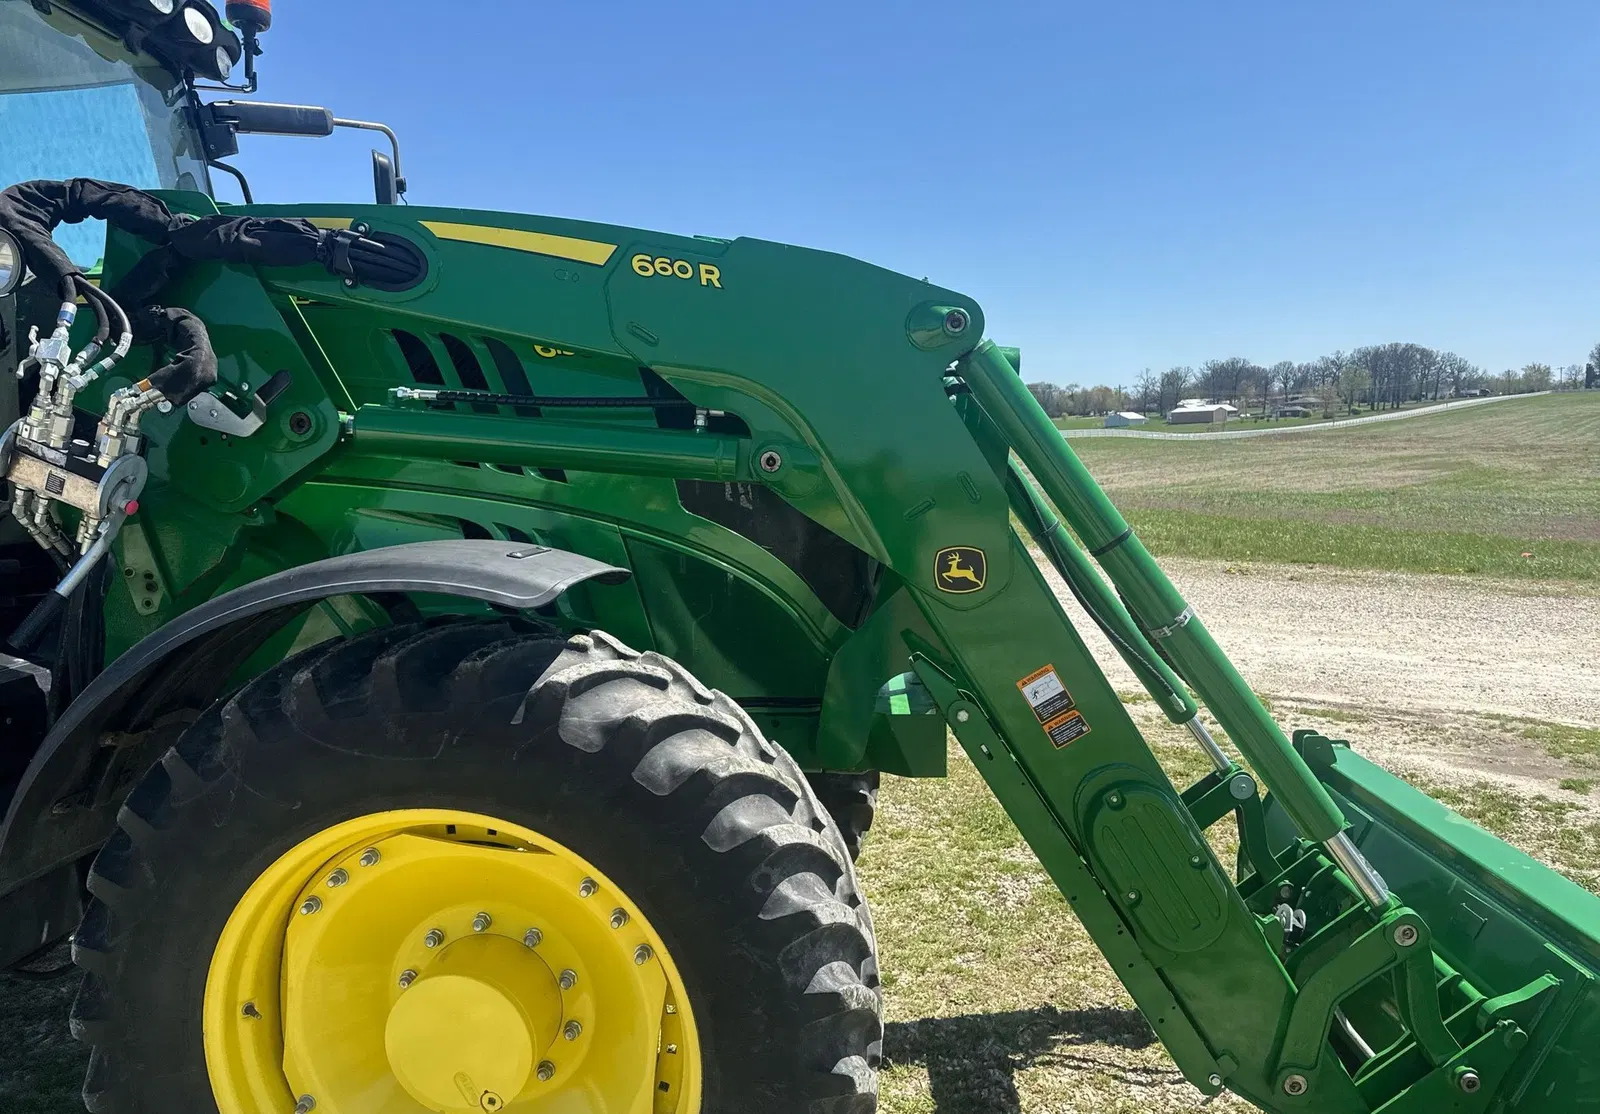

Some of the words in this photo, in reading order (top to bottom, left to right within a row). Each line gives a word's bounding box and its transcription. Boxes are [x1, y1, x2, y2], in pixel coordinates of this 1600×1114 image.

[631, 254, 694, 279] 660
[698, 262, 722, 288] R
[1026, 667, 1050, 683] WARNING
[1053, 711, 1077, 726] WARNING
